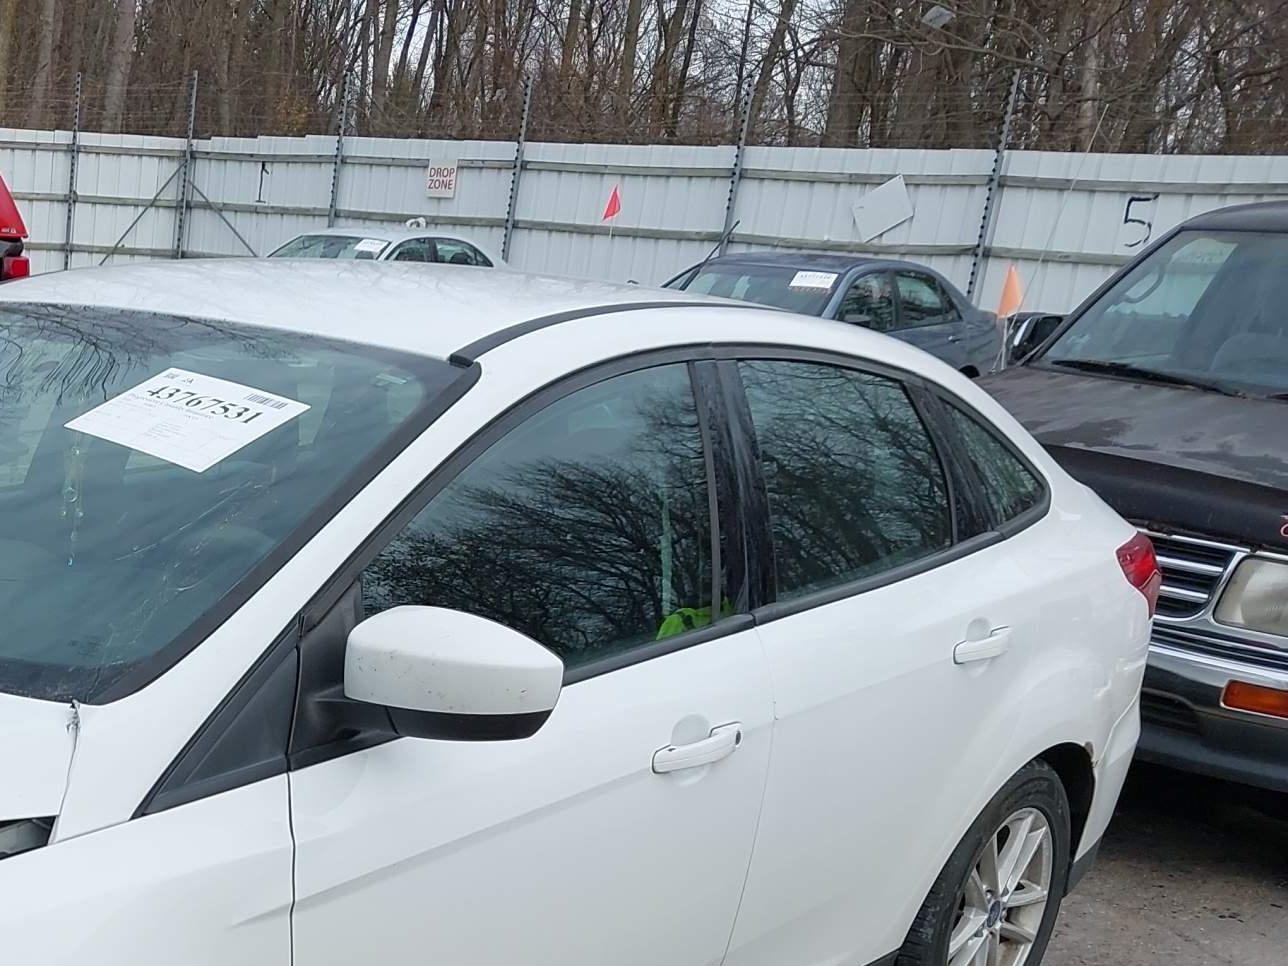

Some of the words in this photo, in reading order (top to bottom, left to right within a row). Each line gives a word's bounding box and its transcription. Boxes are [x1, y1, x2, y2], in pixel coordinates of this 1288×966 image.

[428, 179, 453, 190] ZONE
[429, 167, 455, 178] DROP
[1123, 192, 1161, 248] 5
[147, 385, 263, 424] 43767531
